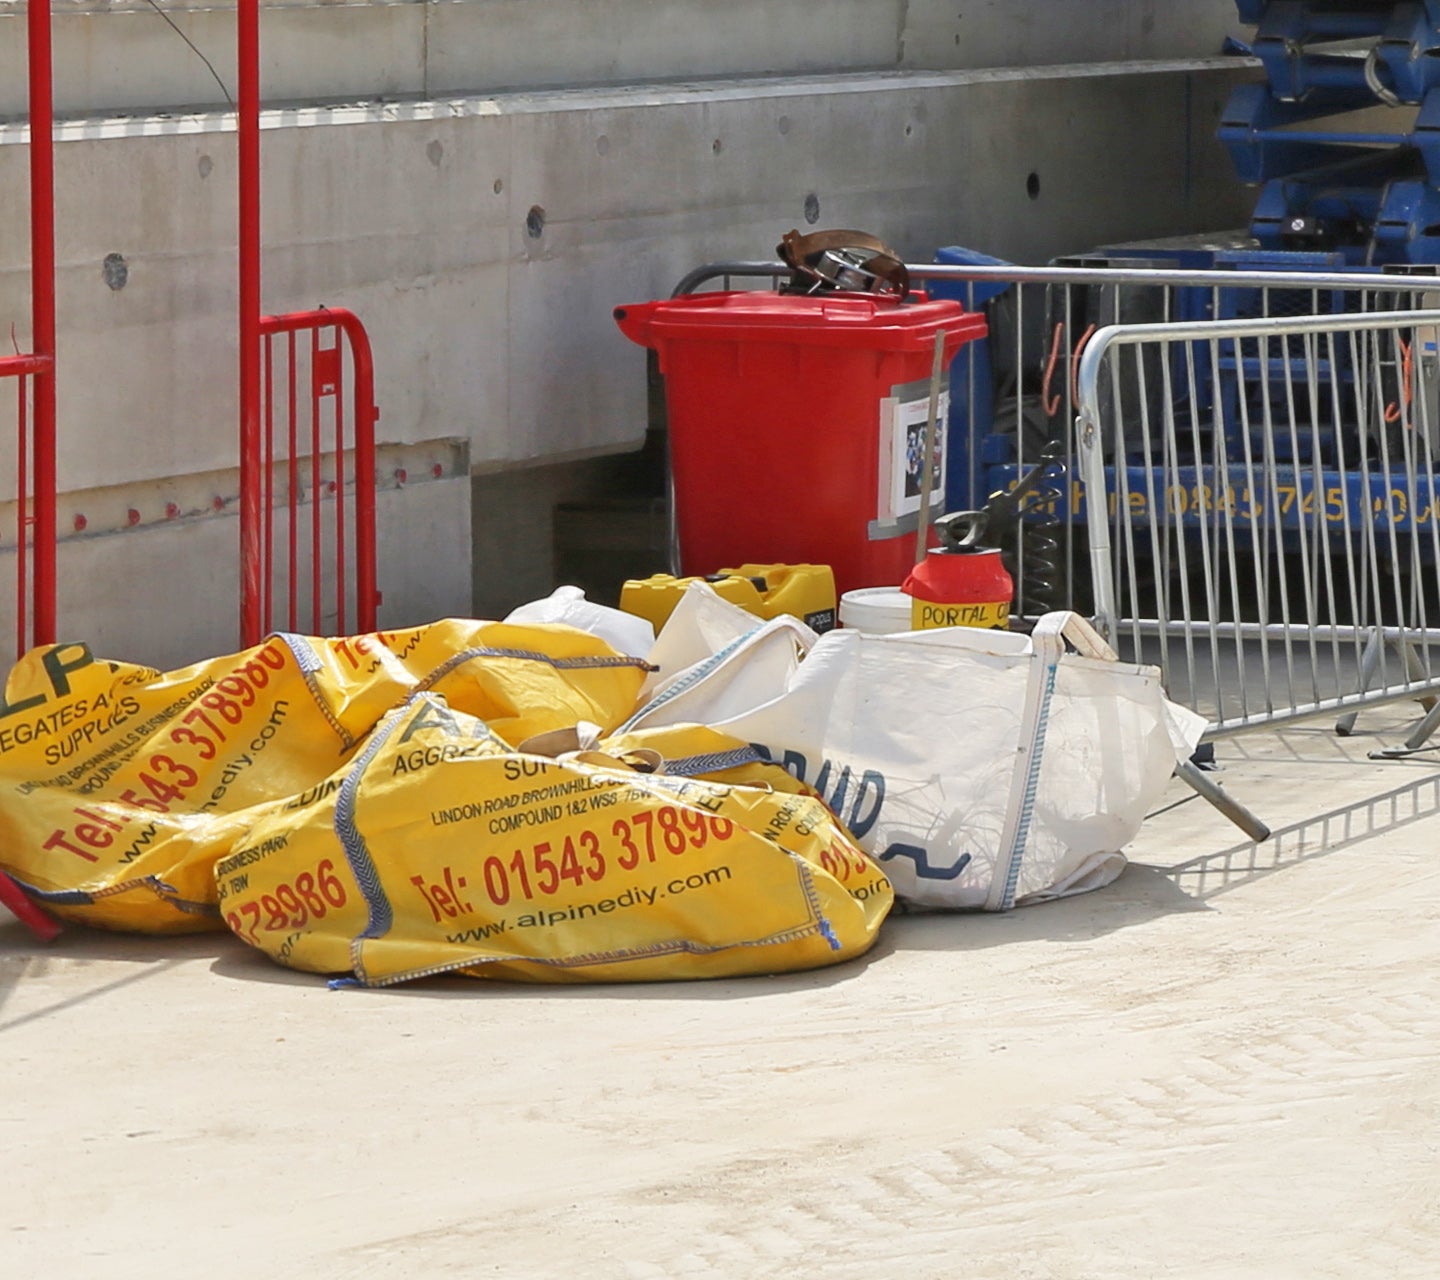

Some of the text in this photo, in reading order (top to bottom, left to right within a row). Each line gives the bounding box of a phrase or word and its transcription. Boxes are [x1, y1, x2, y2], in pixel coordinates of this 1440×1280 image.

[1072, 480, 1146, 516] hre
[922, 603, 989, 627] PORTAL
[431, 804, 483, 827] LINDON
[483, 793, 520, 815] ROAD
[488, 808, 563, 835] COMPOUND
[410, 867, 475, 923] Tel:
[483, 829, 606, 907] 01543
[445, 864, 733, 944] www.alpinediy.com
